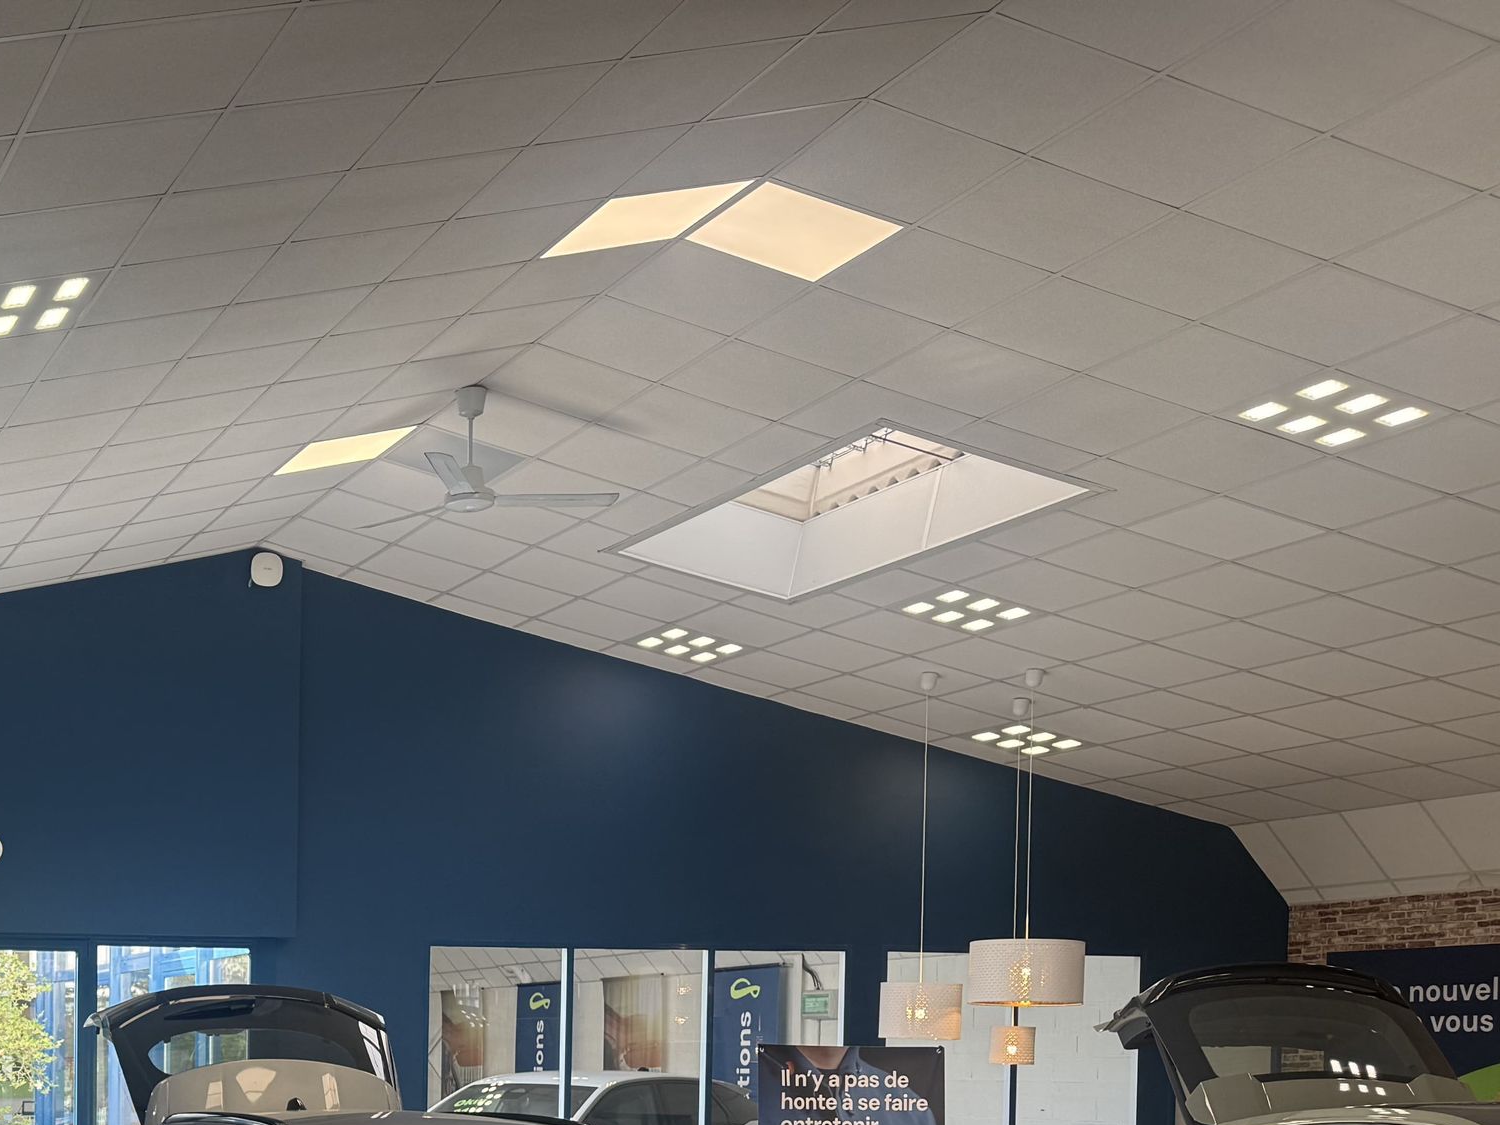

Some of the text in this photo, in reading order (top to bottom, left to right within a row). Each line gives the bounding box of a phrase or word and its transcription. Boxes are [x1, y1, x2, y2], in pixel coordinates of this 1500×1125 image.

[1409, 976, 1499, 1002] nouvel
[1430, 1014, 1494, 1033] vous
[780, 1069, 909, 1093] Il n'y a pas de
[780, 1092, 929, 1112] honte à se faire
